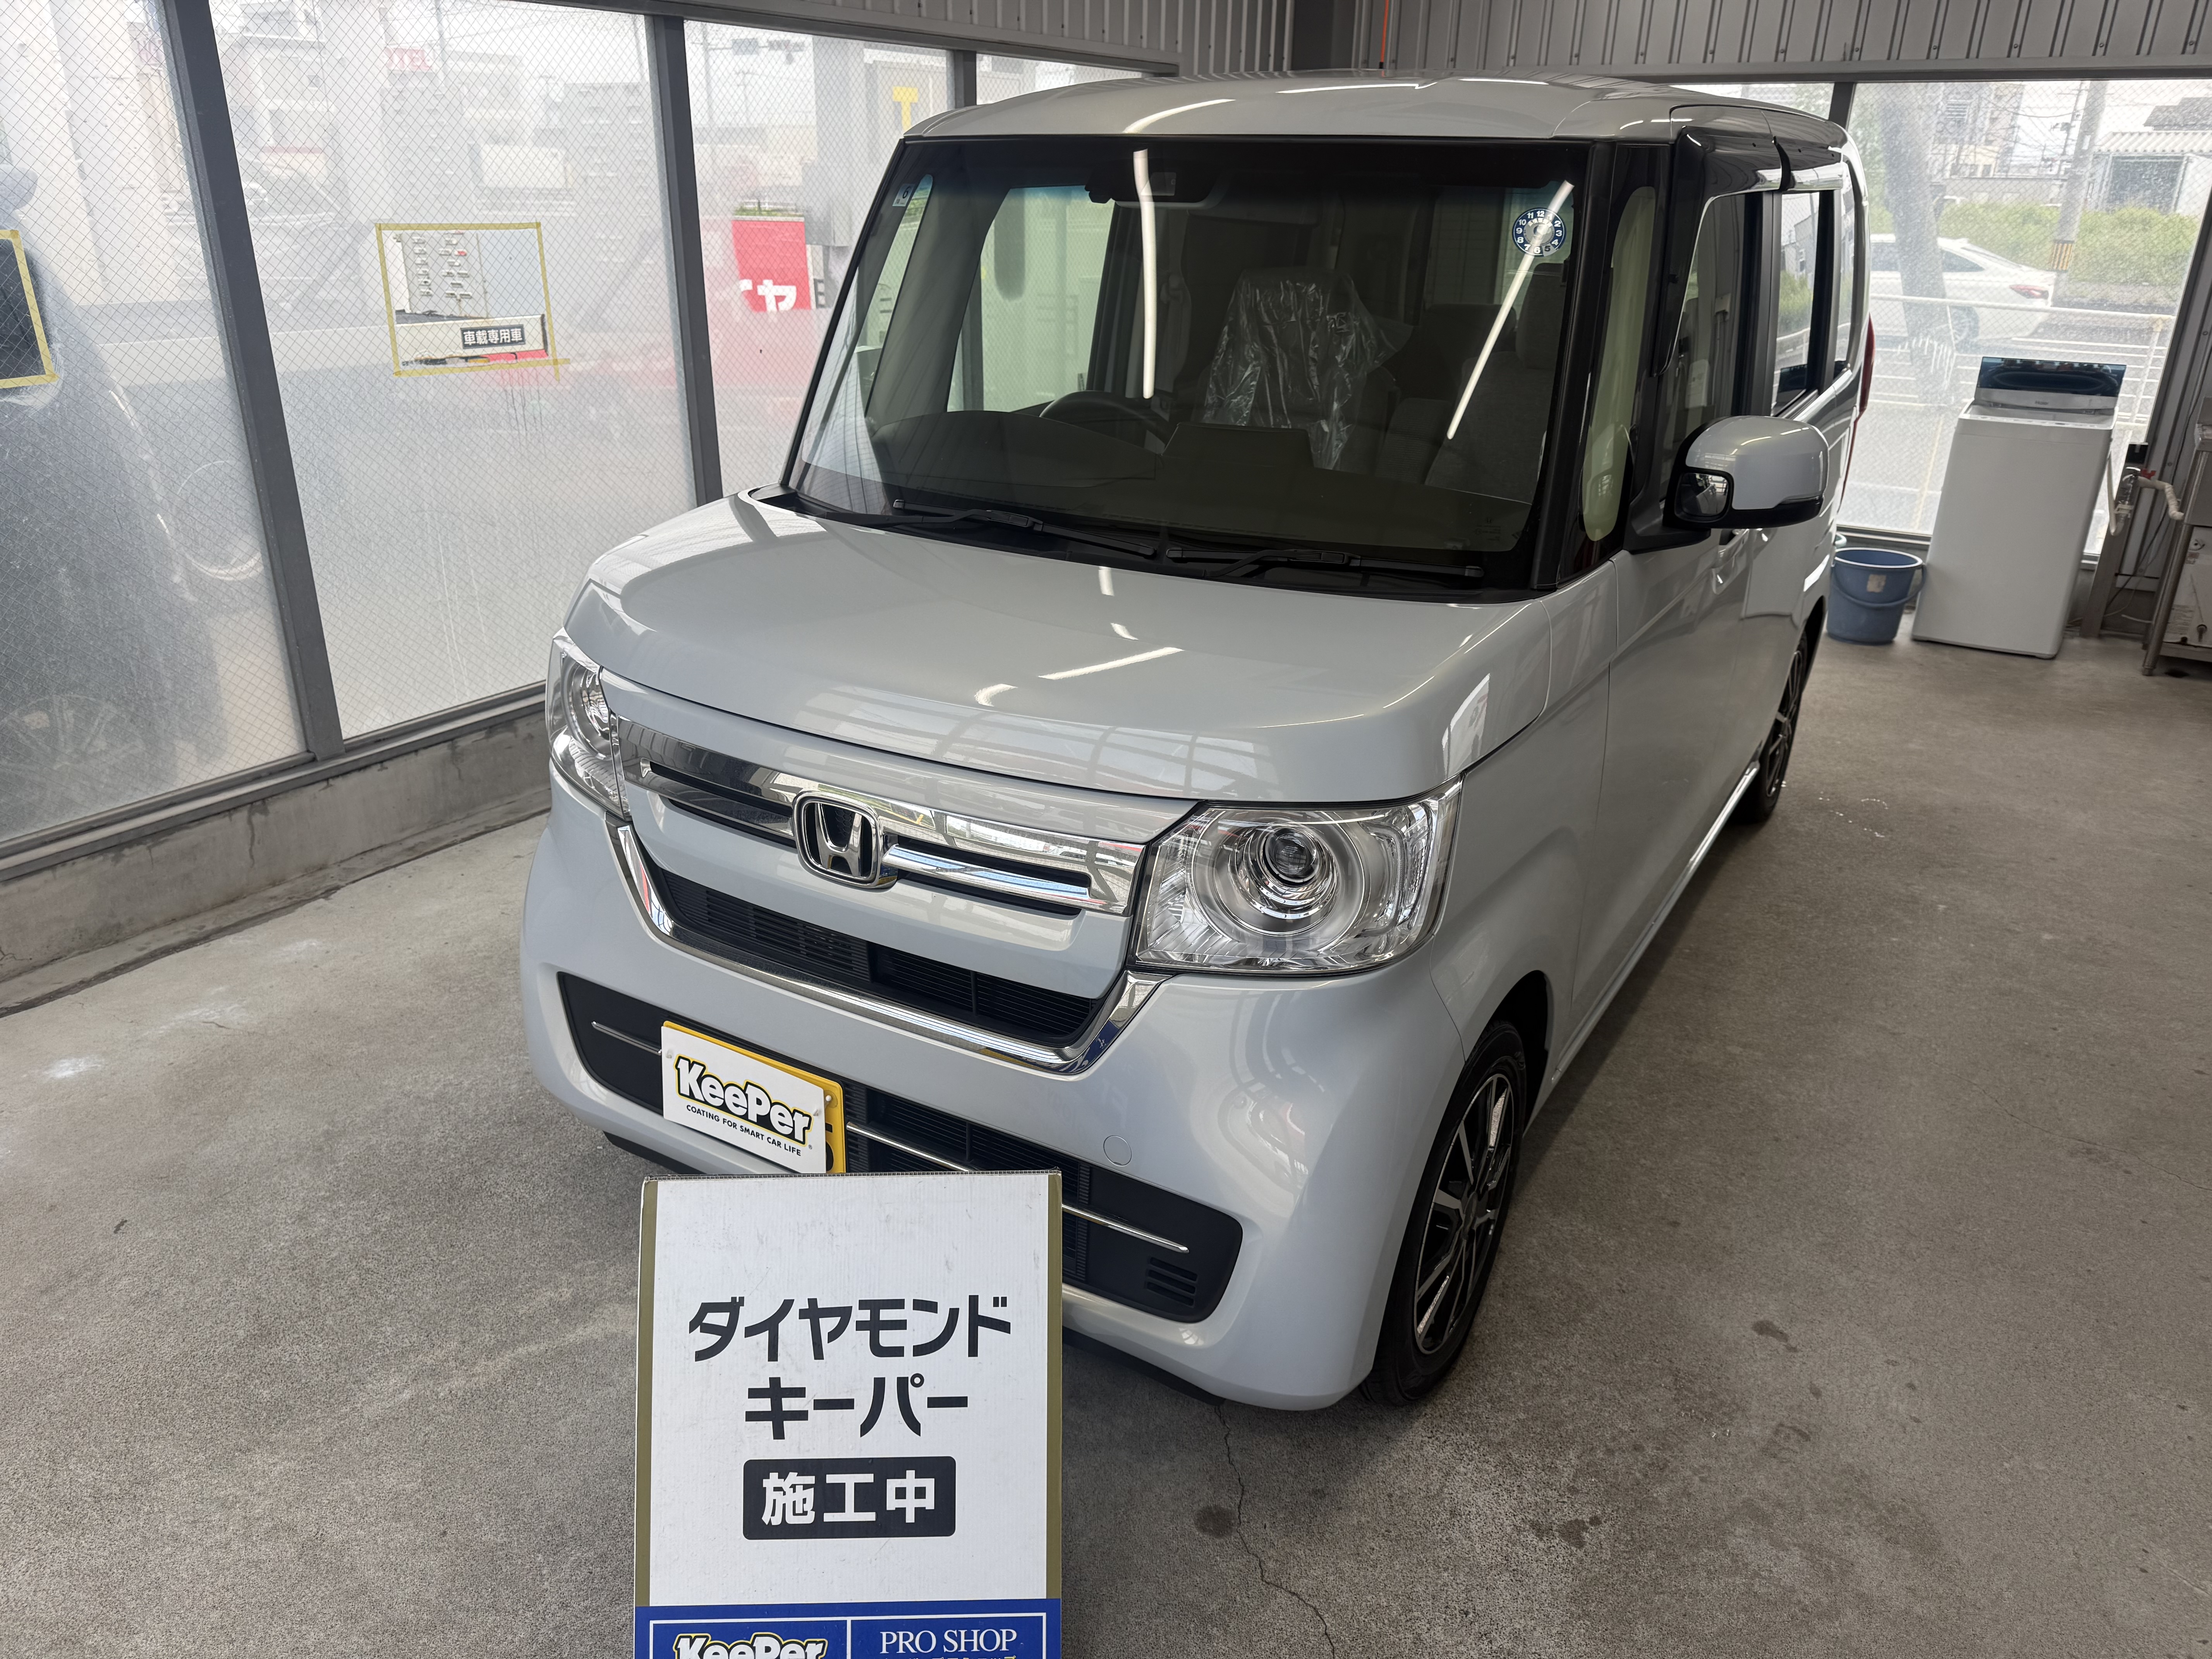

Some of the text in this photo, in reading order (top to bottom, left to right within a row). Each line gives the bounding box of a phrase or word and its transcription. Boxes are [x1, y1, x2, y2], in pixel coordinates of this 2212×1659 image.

[902, 186, 911, 199] 6
[463, 328, 523, 345] 車載専用車
[675, 1056, 812, 1145] KeePer
[687, 1105, 801, 1156] COATING FOR SMART CAR LIFE
[689, 1295, 1011, 1362] ダイヤモンド
[745, 1373, 968, 1440] キーパー
[761, 1470, 936, 1526] 施工中
[879, 1629, 1017, 1654] PRO SHOP
